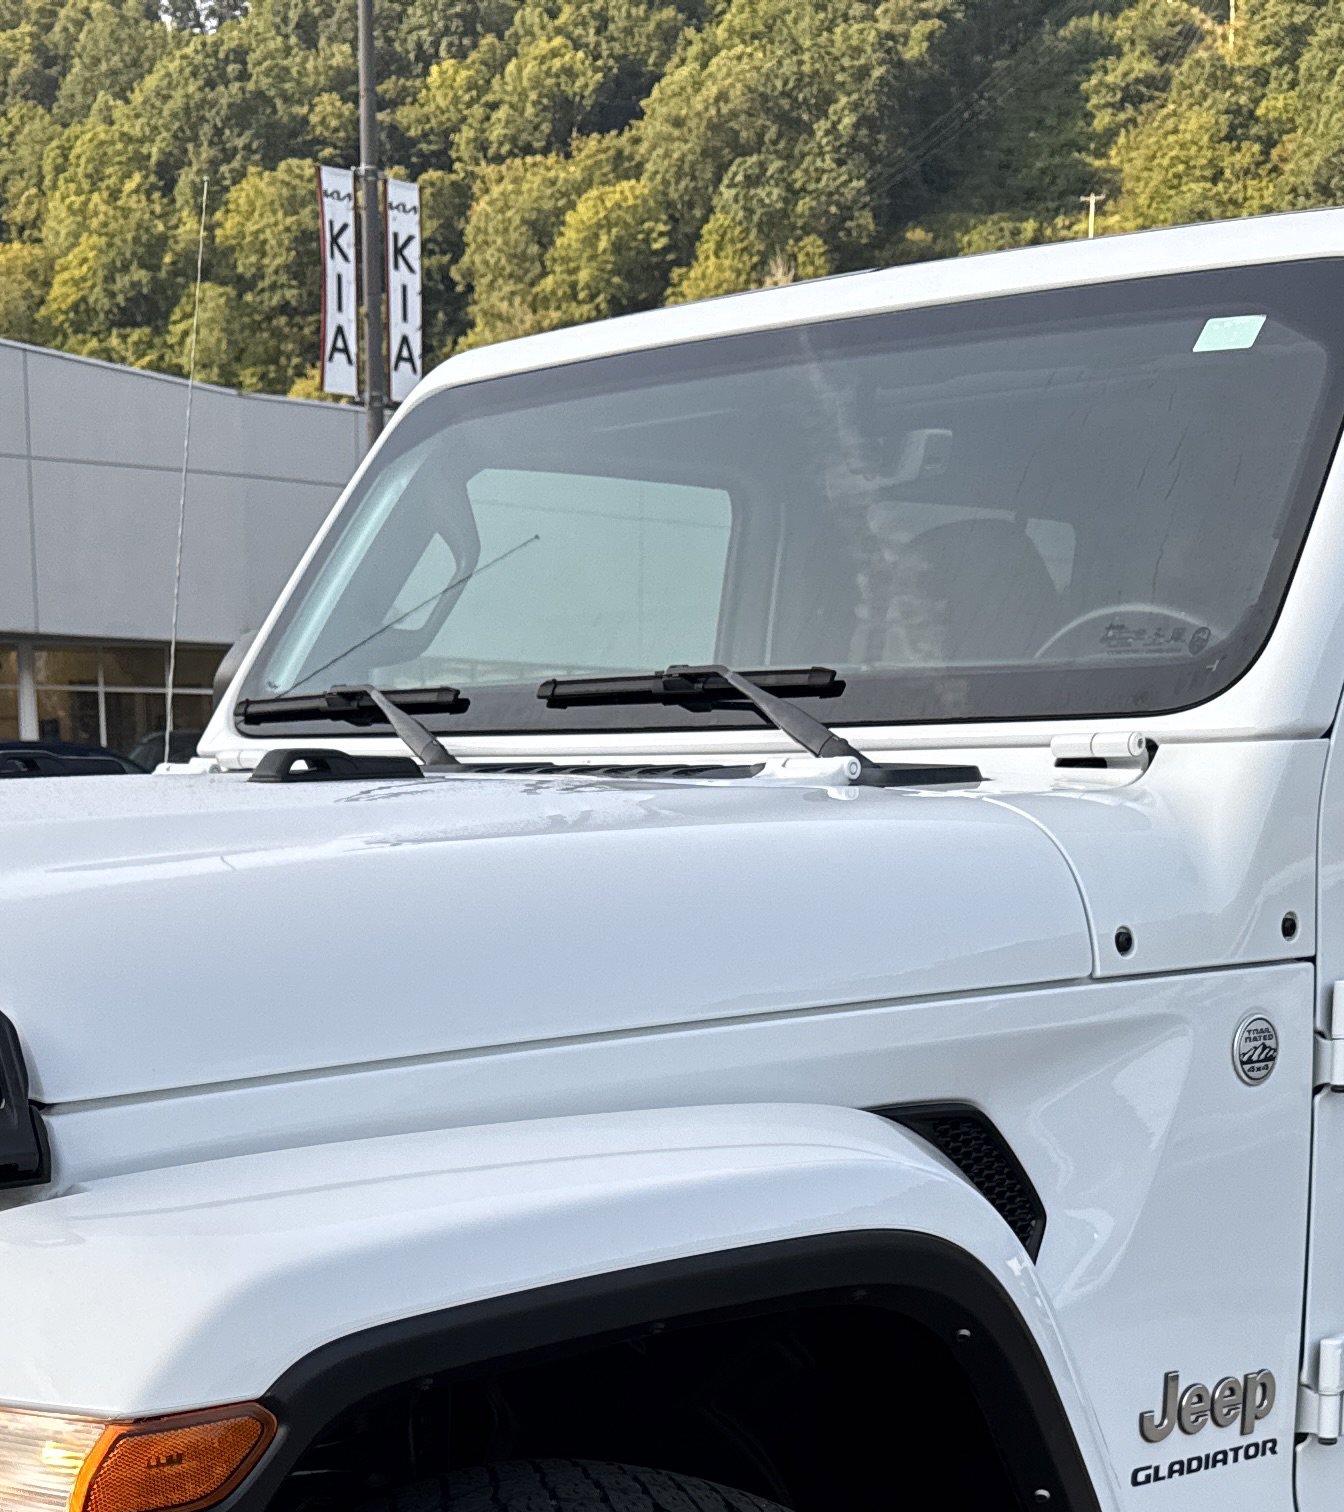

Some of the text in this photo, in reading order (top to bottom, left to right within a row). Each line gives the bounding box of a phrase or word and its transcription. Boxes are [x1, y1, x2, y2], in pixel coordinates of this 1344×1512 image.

[327, 219, 354, 366] KIA
[392, 231, 418, 375] KIA
[1244, 1034, 1274, 1044] RATED
[1138, 1368, 1277, 1444] Jeep
[1130, 1437, 1279, 1488] GLADIATOR
